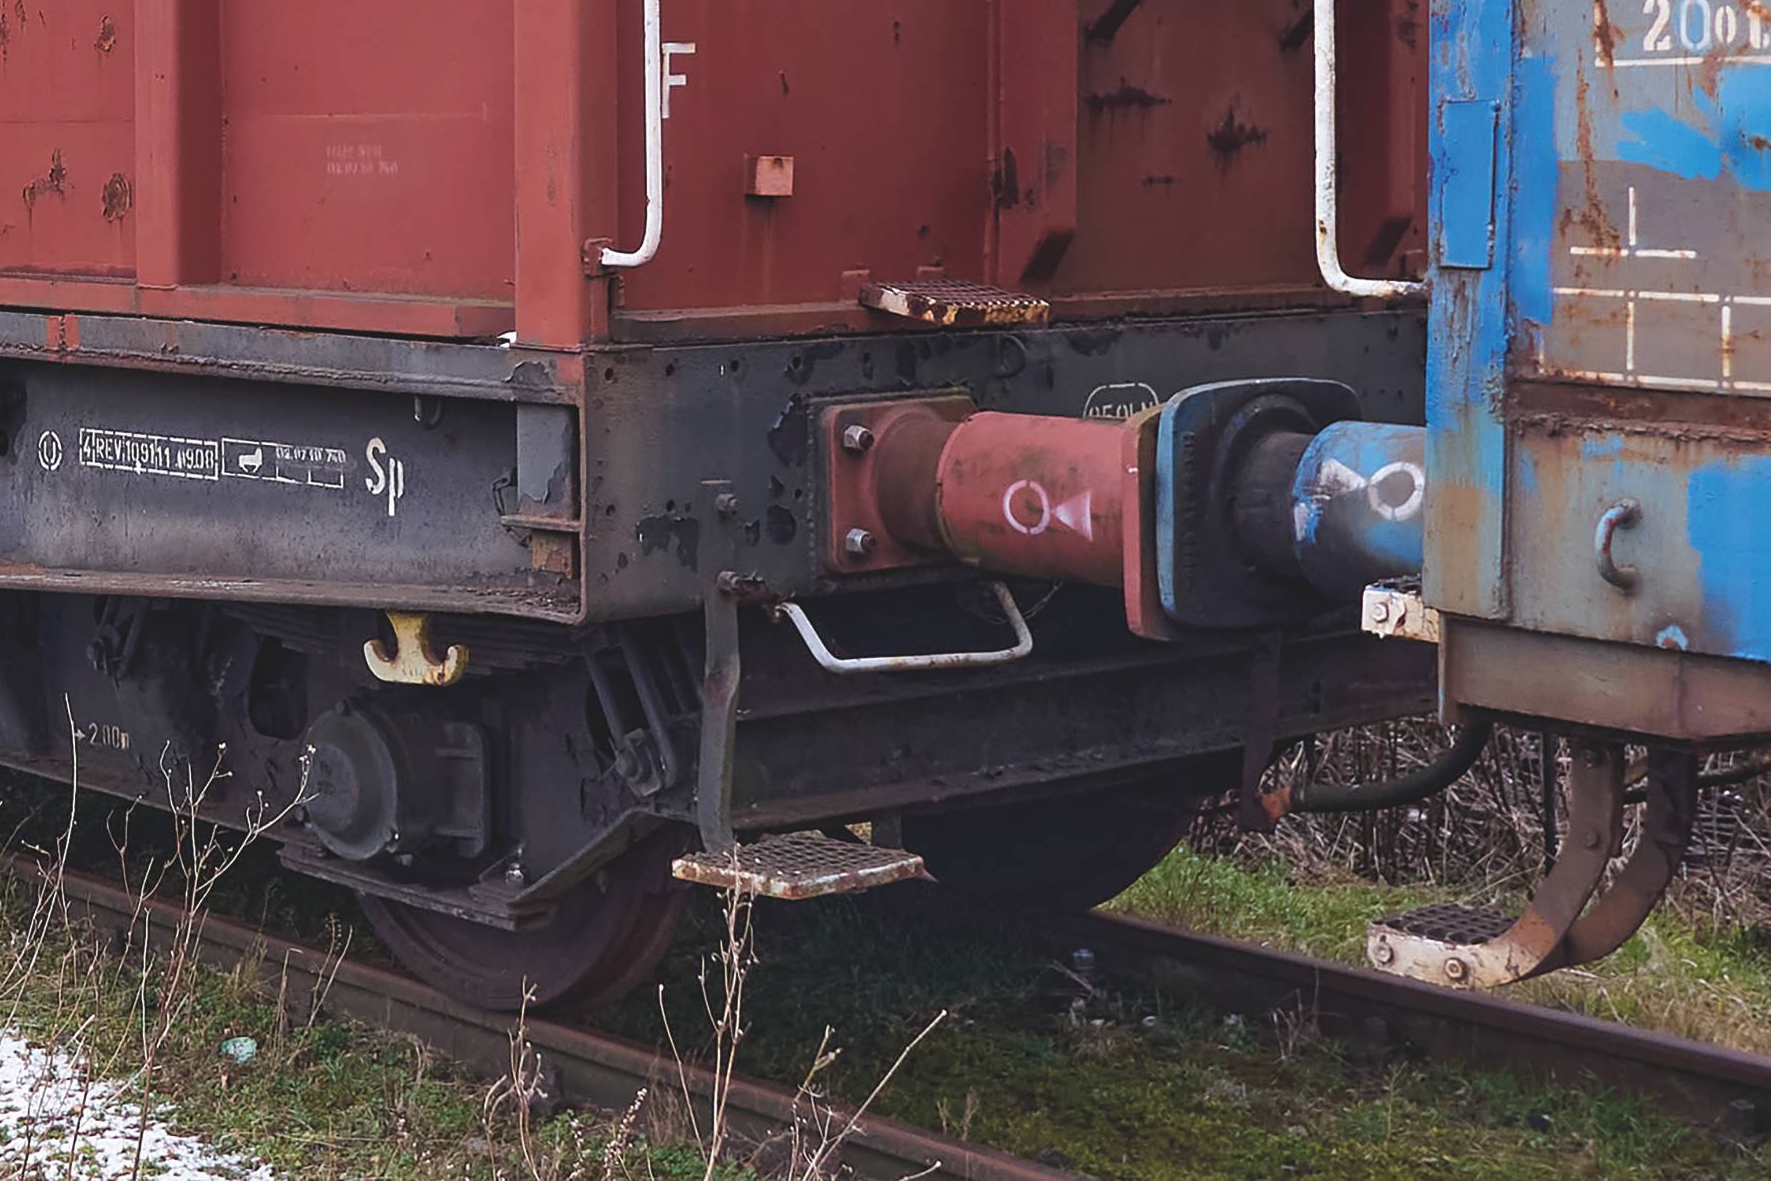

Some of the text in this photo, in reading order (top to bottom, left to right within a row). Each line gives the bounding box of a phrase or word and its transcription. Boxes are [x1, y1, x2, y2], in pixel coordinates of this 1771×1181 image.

[661, 42, 696, 119] F
[95, 437, 123, 461] REV
[365, 436, 405, 517] Sp
